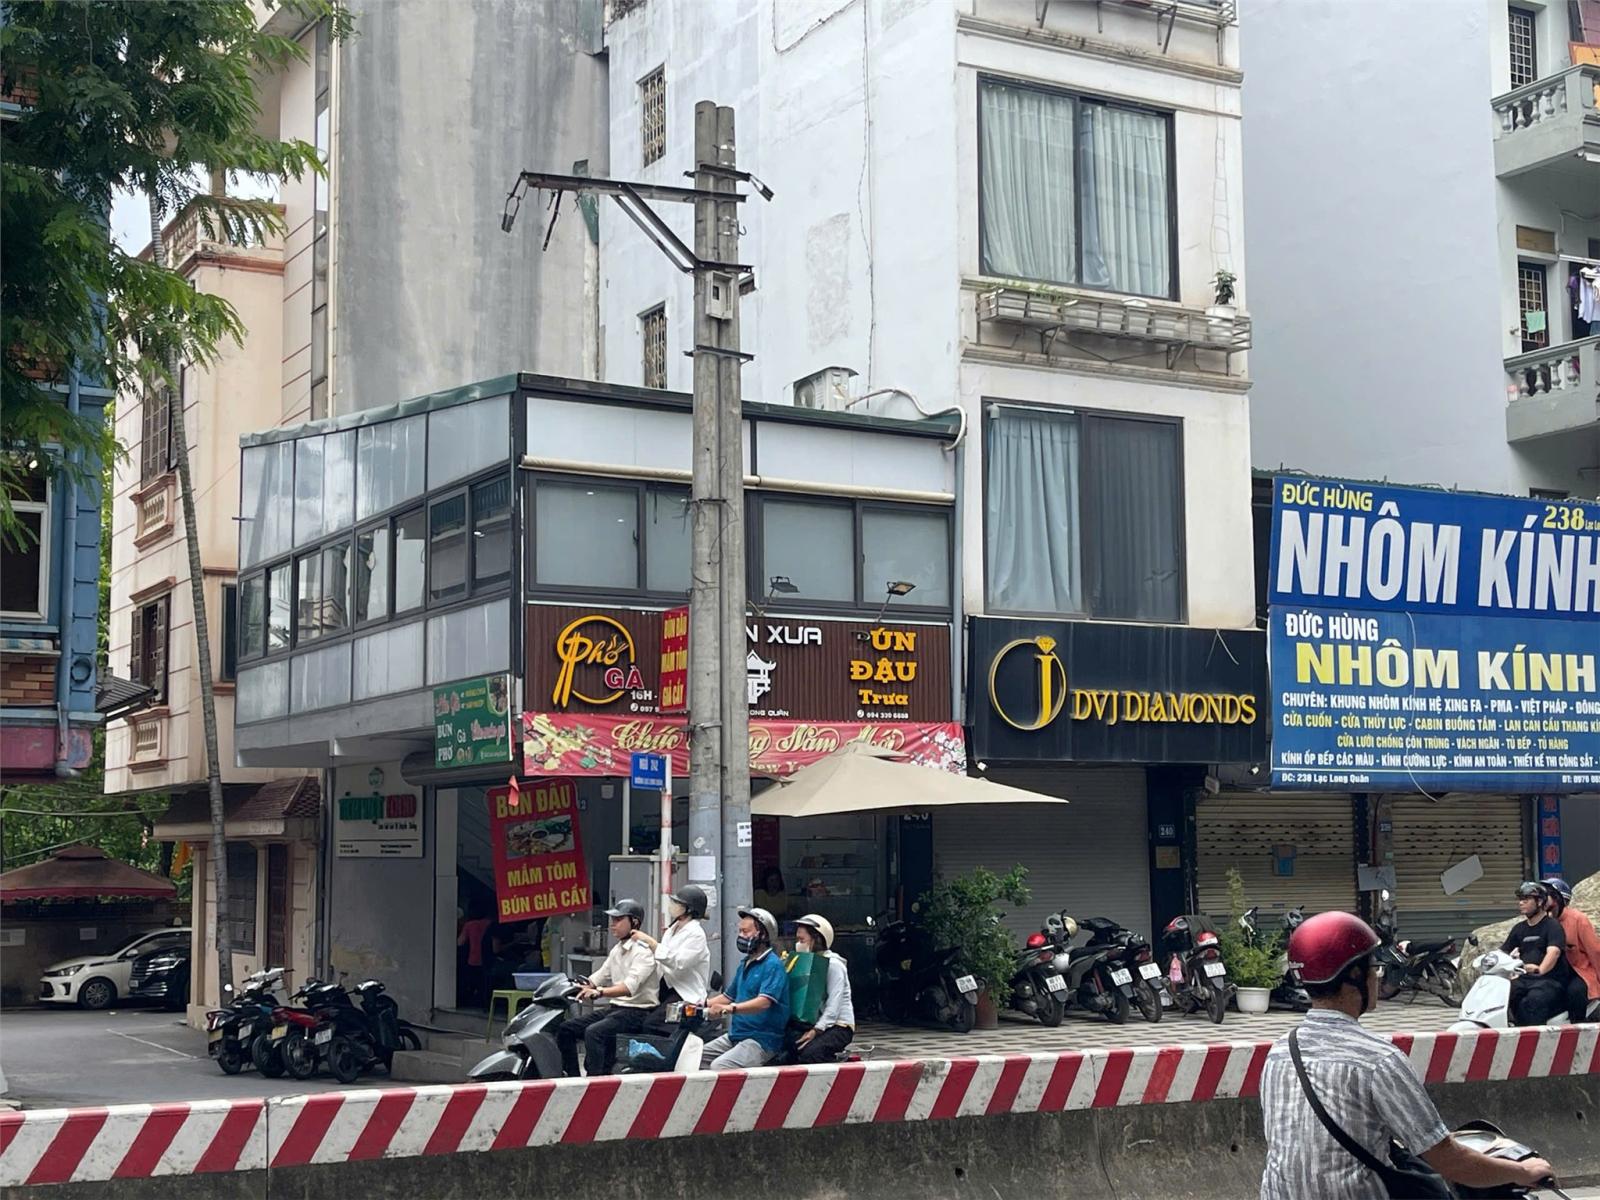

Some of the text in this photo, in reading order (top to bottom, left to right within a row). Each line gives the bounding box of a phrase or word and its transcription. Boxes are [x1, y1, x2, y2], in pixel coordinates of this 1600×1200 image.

[1282, 481, 1373, 511] ĐỨC HÙNG
[1543, 505, 1584, 529] 238
[1277, 501, 1461, 604] NHÔM
[1285, 609, 1379, 641] ĐỨC HÙNG
[605, 665, 644, 688] GÀ
[850, 657, 917, 683] ĐẬU
[1296, 638, 1596, 692] NHÔM KÍNH
[1071, 688, 1257, 726] DVJ DIAMONDS
[1282, 691, 1328, 708] CHUYÊN:
[1330, 694, 1366, 709] KHUNG
[1369, 693, 1399, 710] NHÔM
[1402, 695, 1426, 711] KÍNH
[1428, 695, 1441, 715] HỆ
[1444, 698, 1468, 712] XING
[1470, 699, 1482, 712] FA
[1490, 700, 1512, 712] PMA
[1521, 697, 1540, 715] VIỆT
[1543, 698, 1567, 713] PHÁP
[1415, 717, 1442, 730] CABIN
[1561, 720, 1588, 733] THANG
[536, 782, 570, 815] ĐẬU
[507, 860, 576, 887] MẮM TÔM
[501, 895, 530, 915] BÚN
